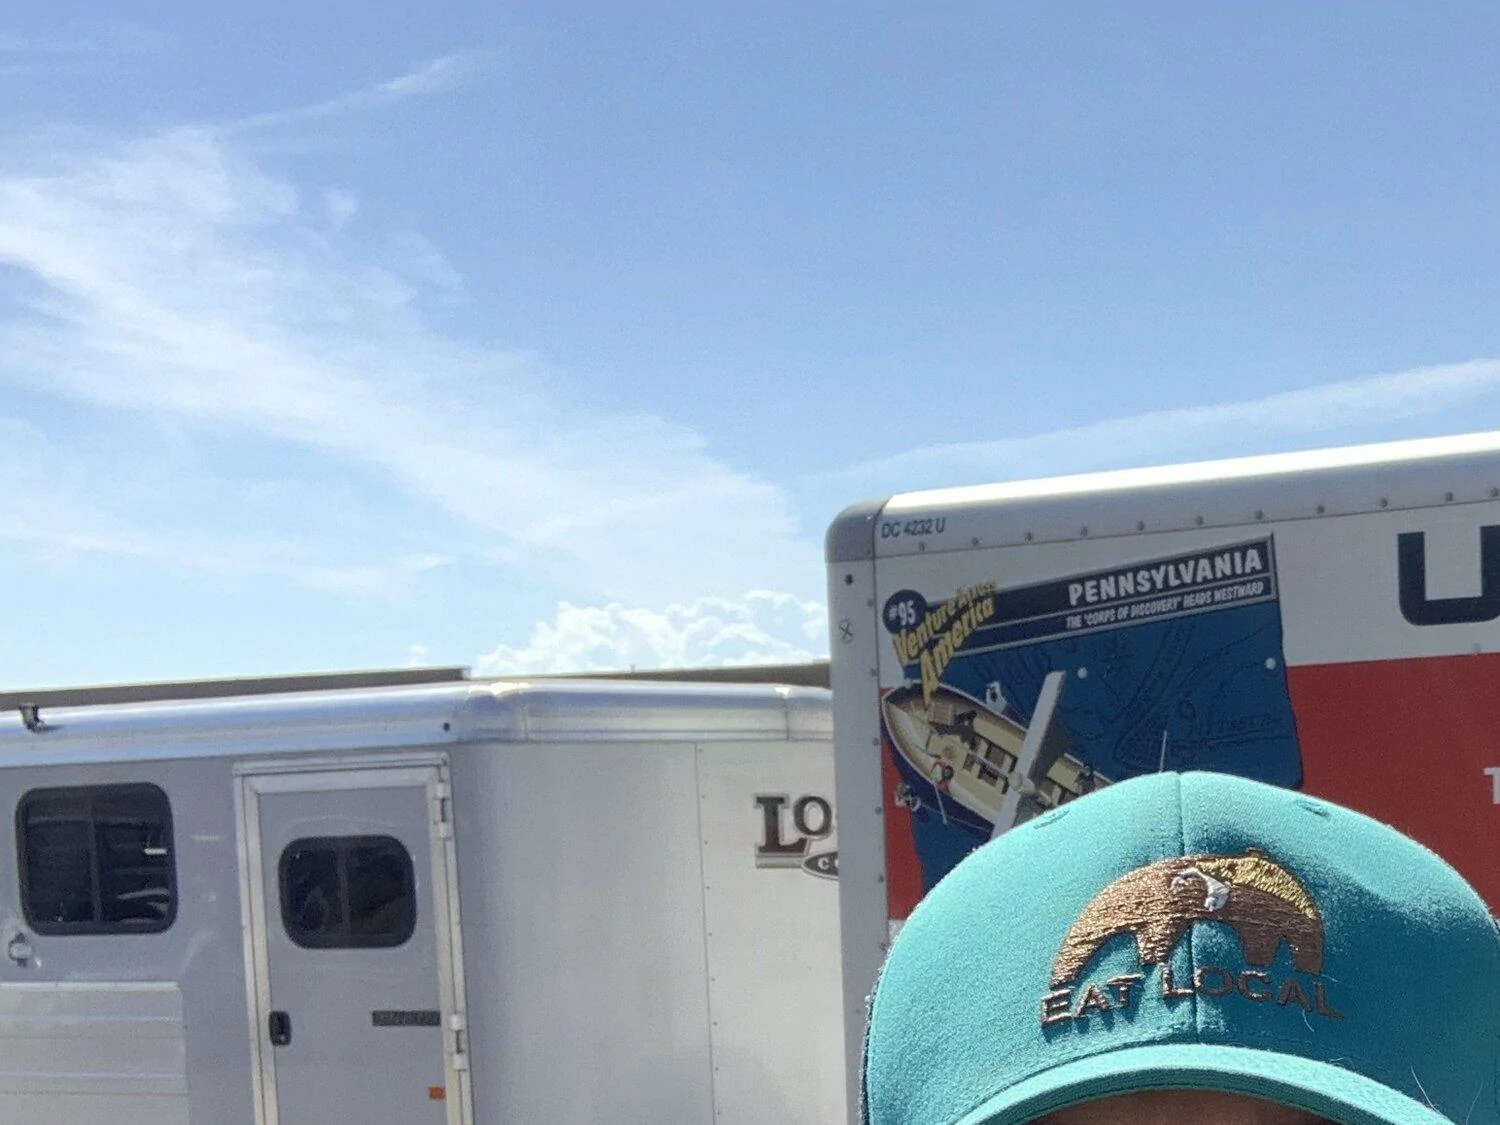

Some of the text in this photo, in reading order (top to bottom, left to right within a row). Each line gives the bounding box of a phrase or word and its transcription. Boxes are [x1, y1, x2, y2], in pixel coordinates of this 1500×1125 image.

[881, 523, 900, 538] DC
[935, 518, 946, 533] U
[1068, 549, 1263, 606] PENNSYLVANIA
[888, 600, 916, 625] #95
[1066, 614, 1082, 629] THE
[1117, 605, 1129, 620] OF
[1183, 589, 1211, 608] HEADS
[920, 597, 995, 704] America
[1040, 963, 1345, 1029] EAT LOCAL
